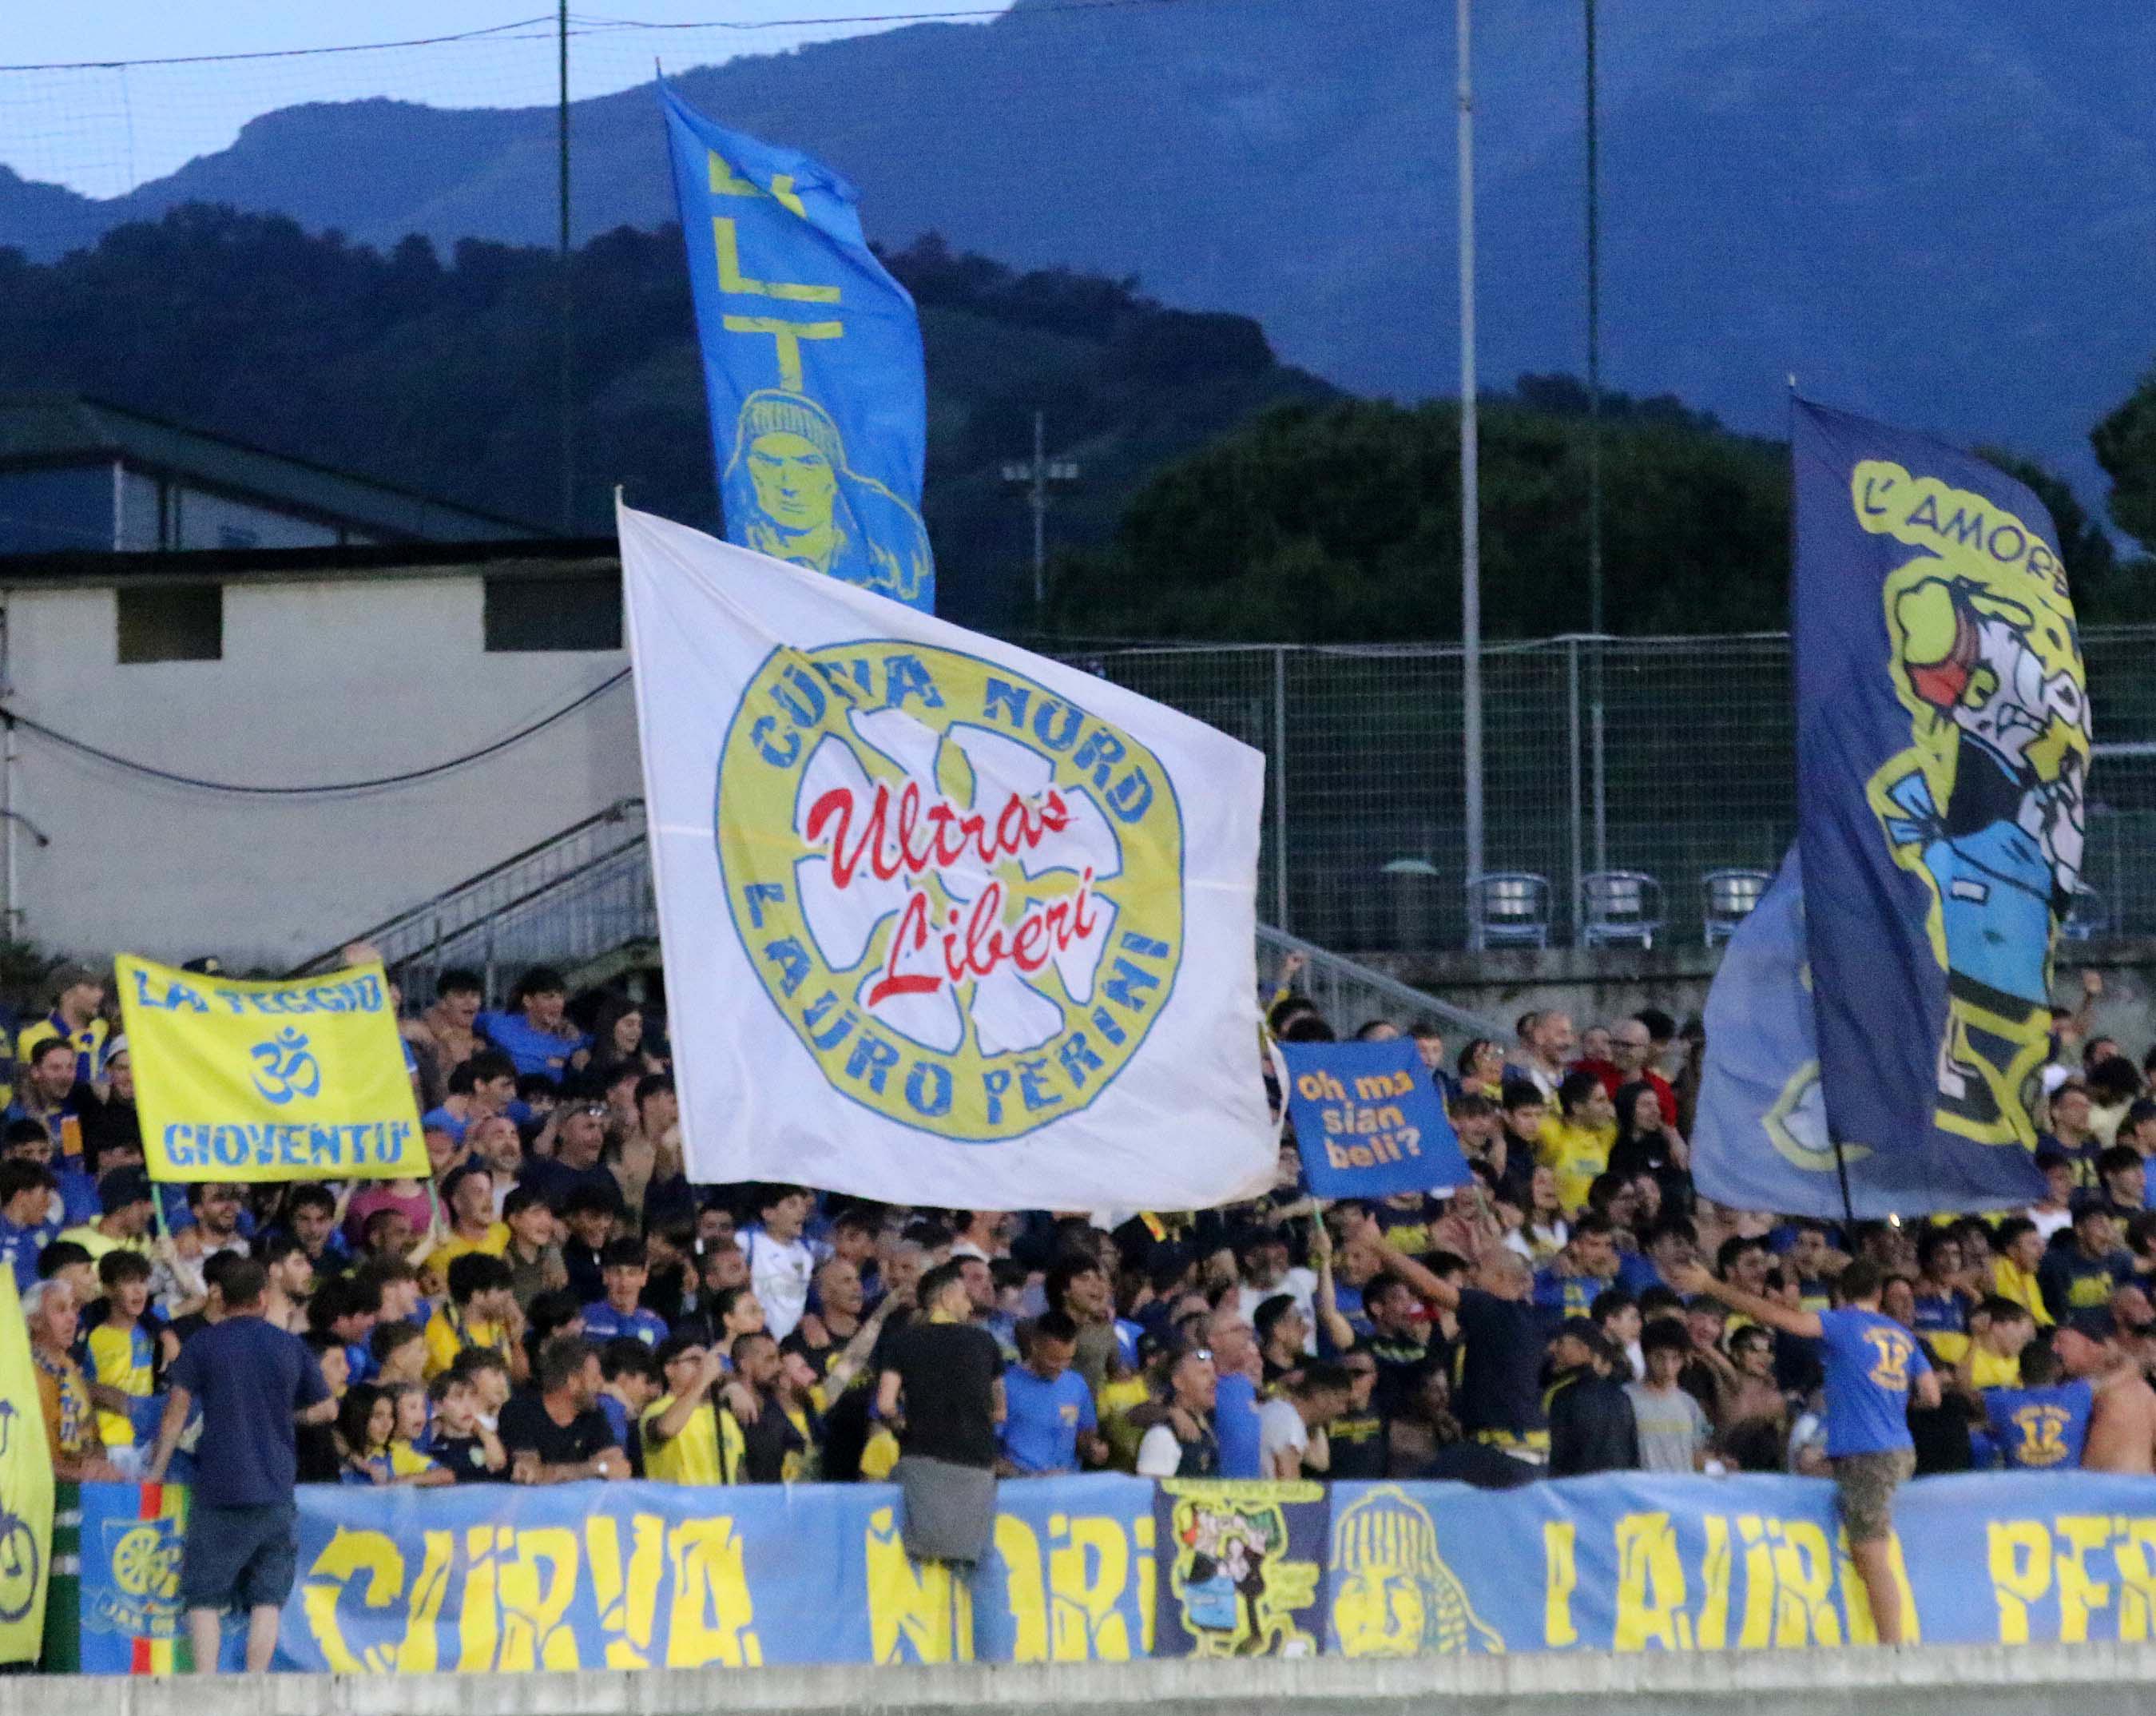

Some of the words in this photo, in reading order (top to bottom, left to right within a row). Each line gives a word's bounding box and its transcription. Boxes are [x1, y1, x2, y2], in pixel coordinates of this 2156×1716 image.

[983, 677, 1153, 824] NORD
[806, 781, 1078, 890] Ultras
[133, 970, 209, 1012] LA
[868, 866, 1098, 1008] Liberi
[743, 883, 954, 1117] LAURO
[982, 931, 1170, 1126] PERINI
[1297, 1069, 1348, 1101] oh
[1321, 1100, 1406, 1134] sian
